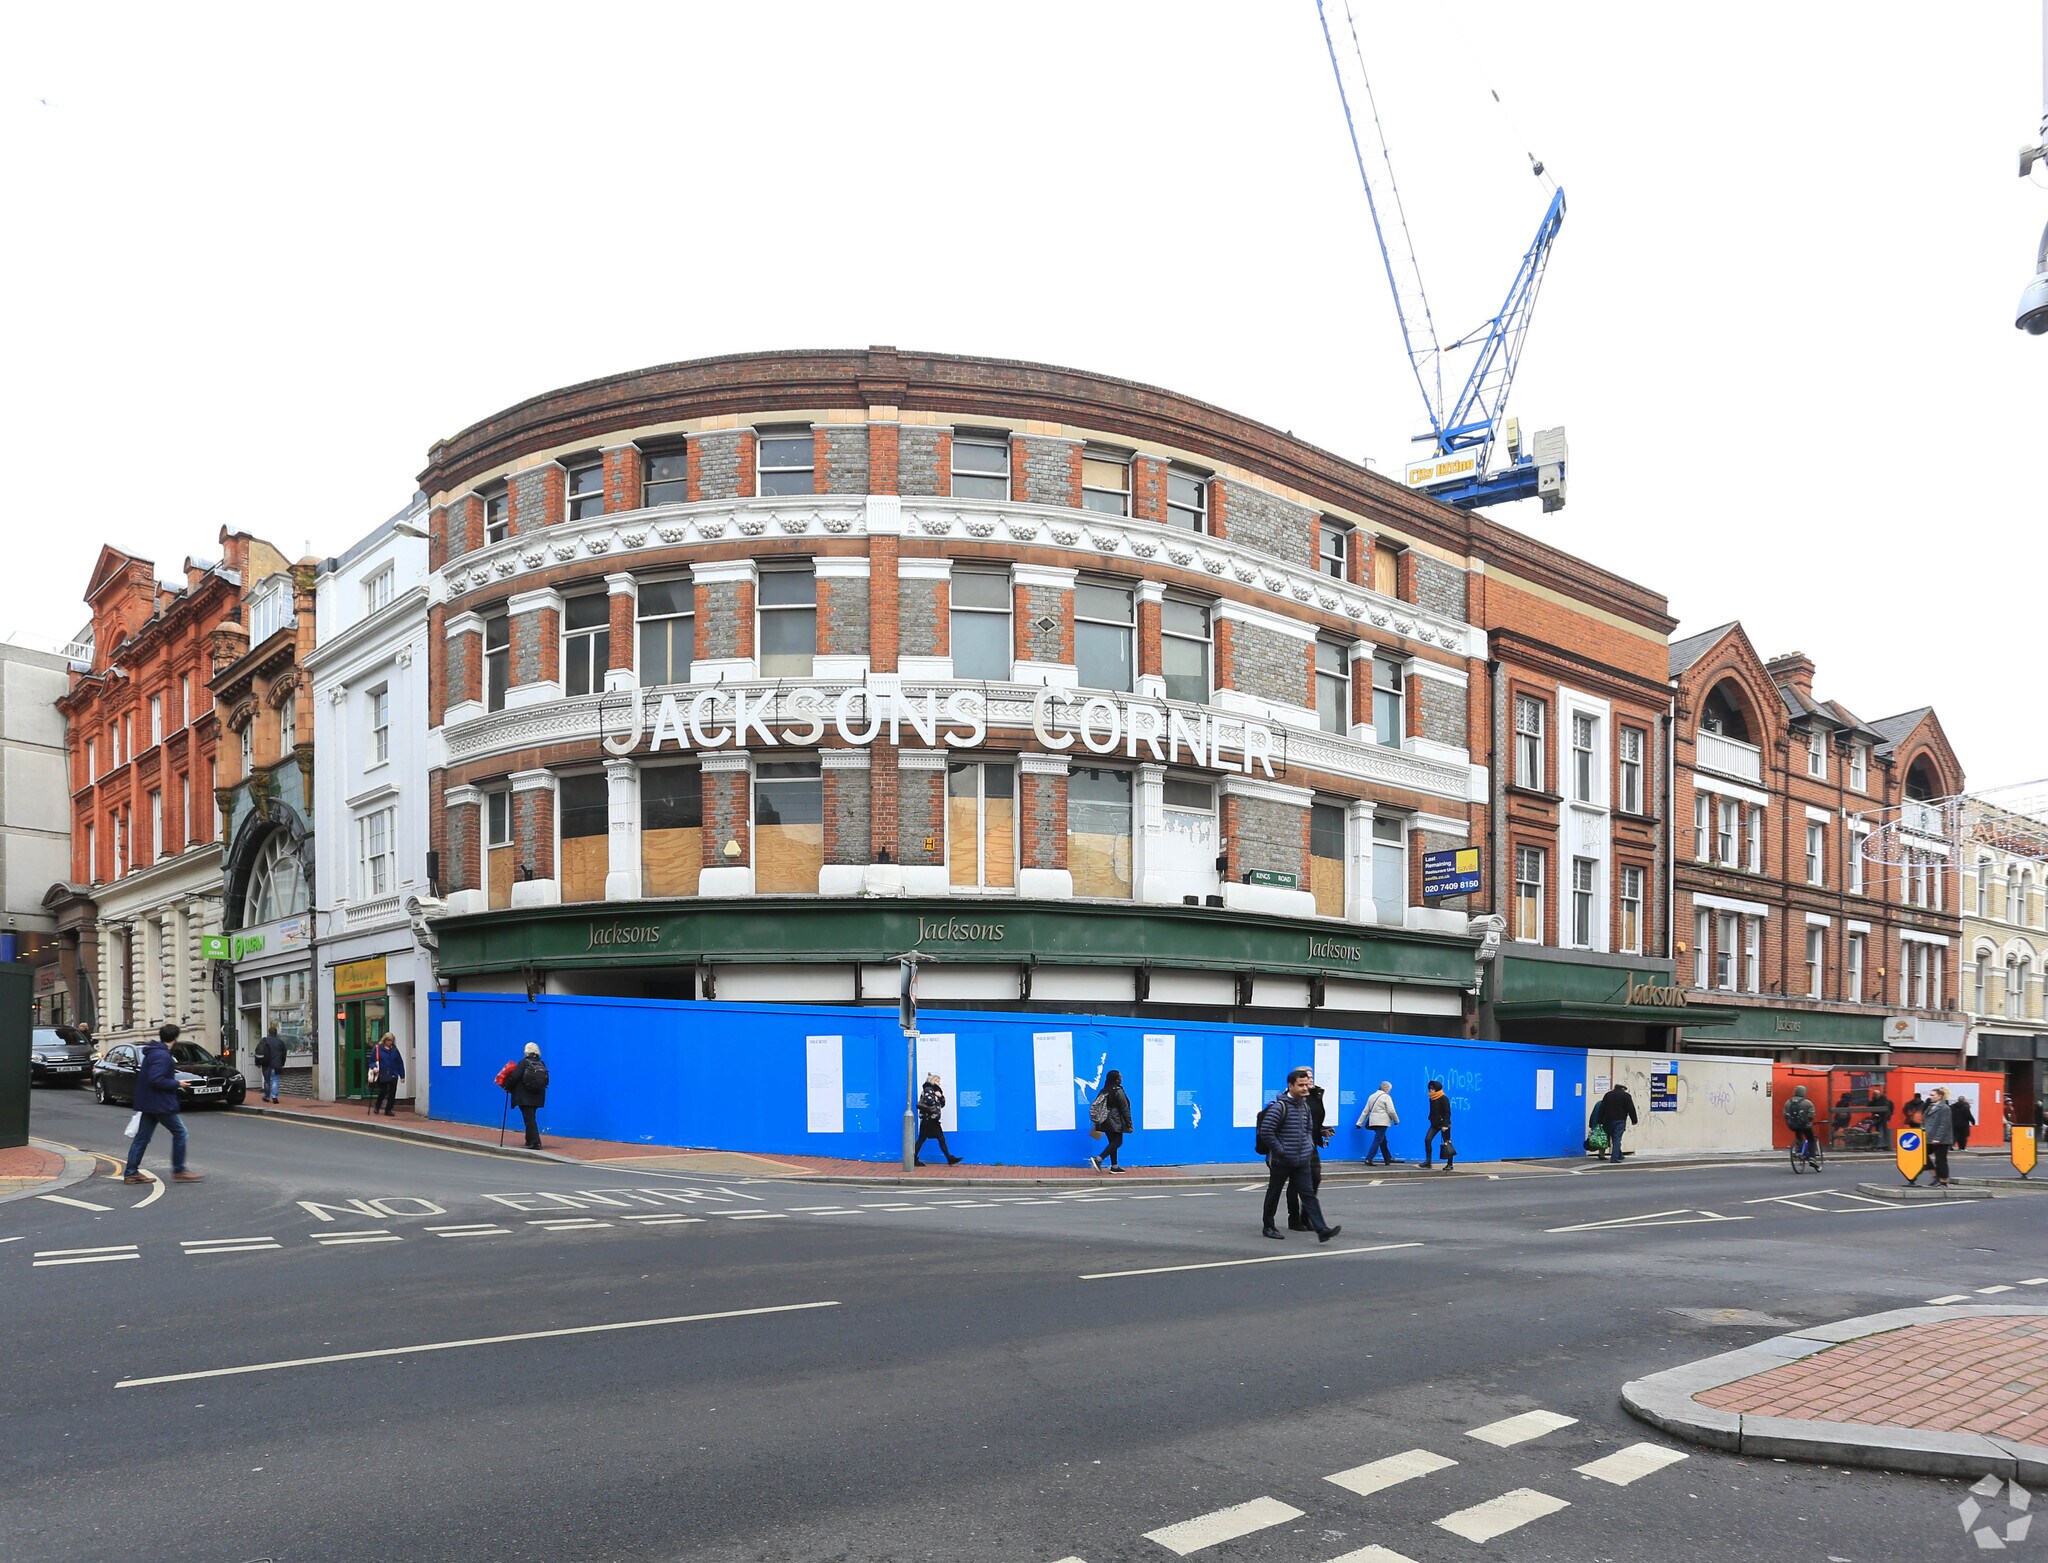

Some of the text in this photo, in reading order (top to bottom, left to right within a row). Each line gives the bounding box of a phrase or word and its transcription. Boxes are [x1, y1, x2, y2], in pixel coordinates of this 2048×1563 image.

[1409, 468, 1433, 484] City
[602, 685, 1275, 778] JACKSONS CORNER
[1278, 875, 1291, 883] ROAD
[1440, 882, 1459, 890] 7409
[1460, 880, 1478, 888] 8150
[586, 922, 660, 950] Jacksons
[914, 916, 1005, 947] Jacksons
[1306, 936, 1361, 962] Jacksons
[1622, 970, 1688, 1008] Jacksons
[1775, 1016, 1801, 1032] Jacksons
[1448, 1068, 1482, 1091] MORE
[296, 1186, 765, 1221] NO ENTRY
